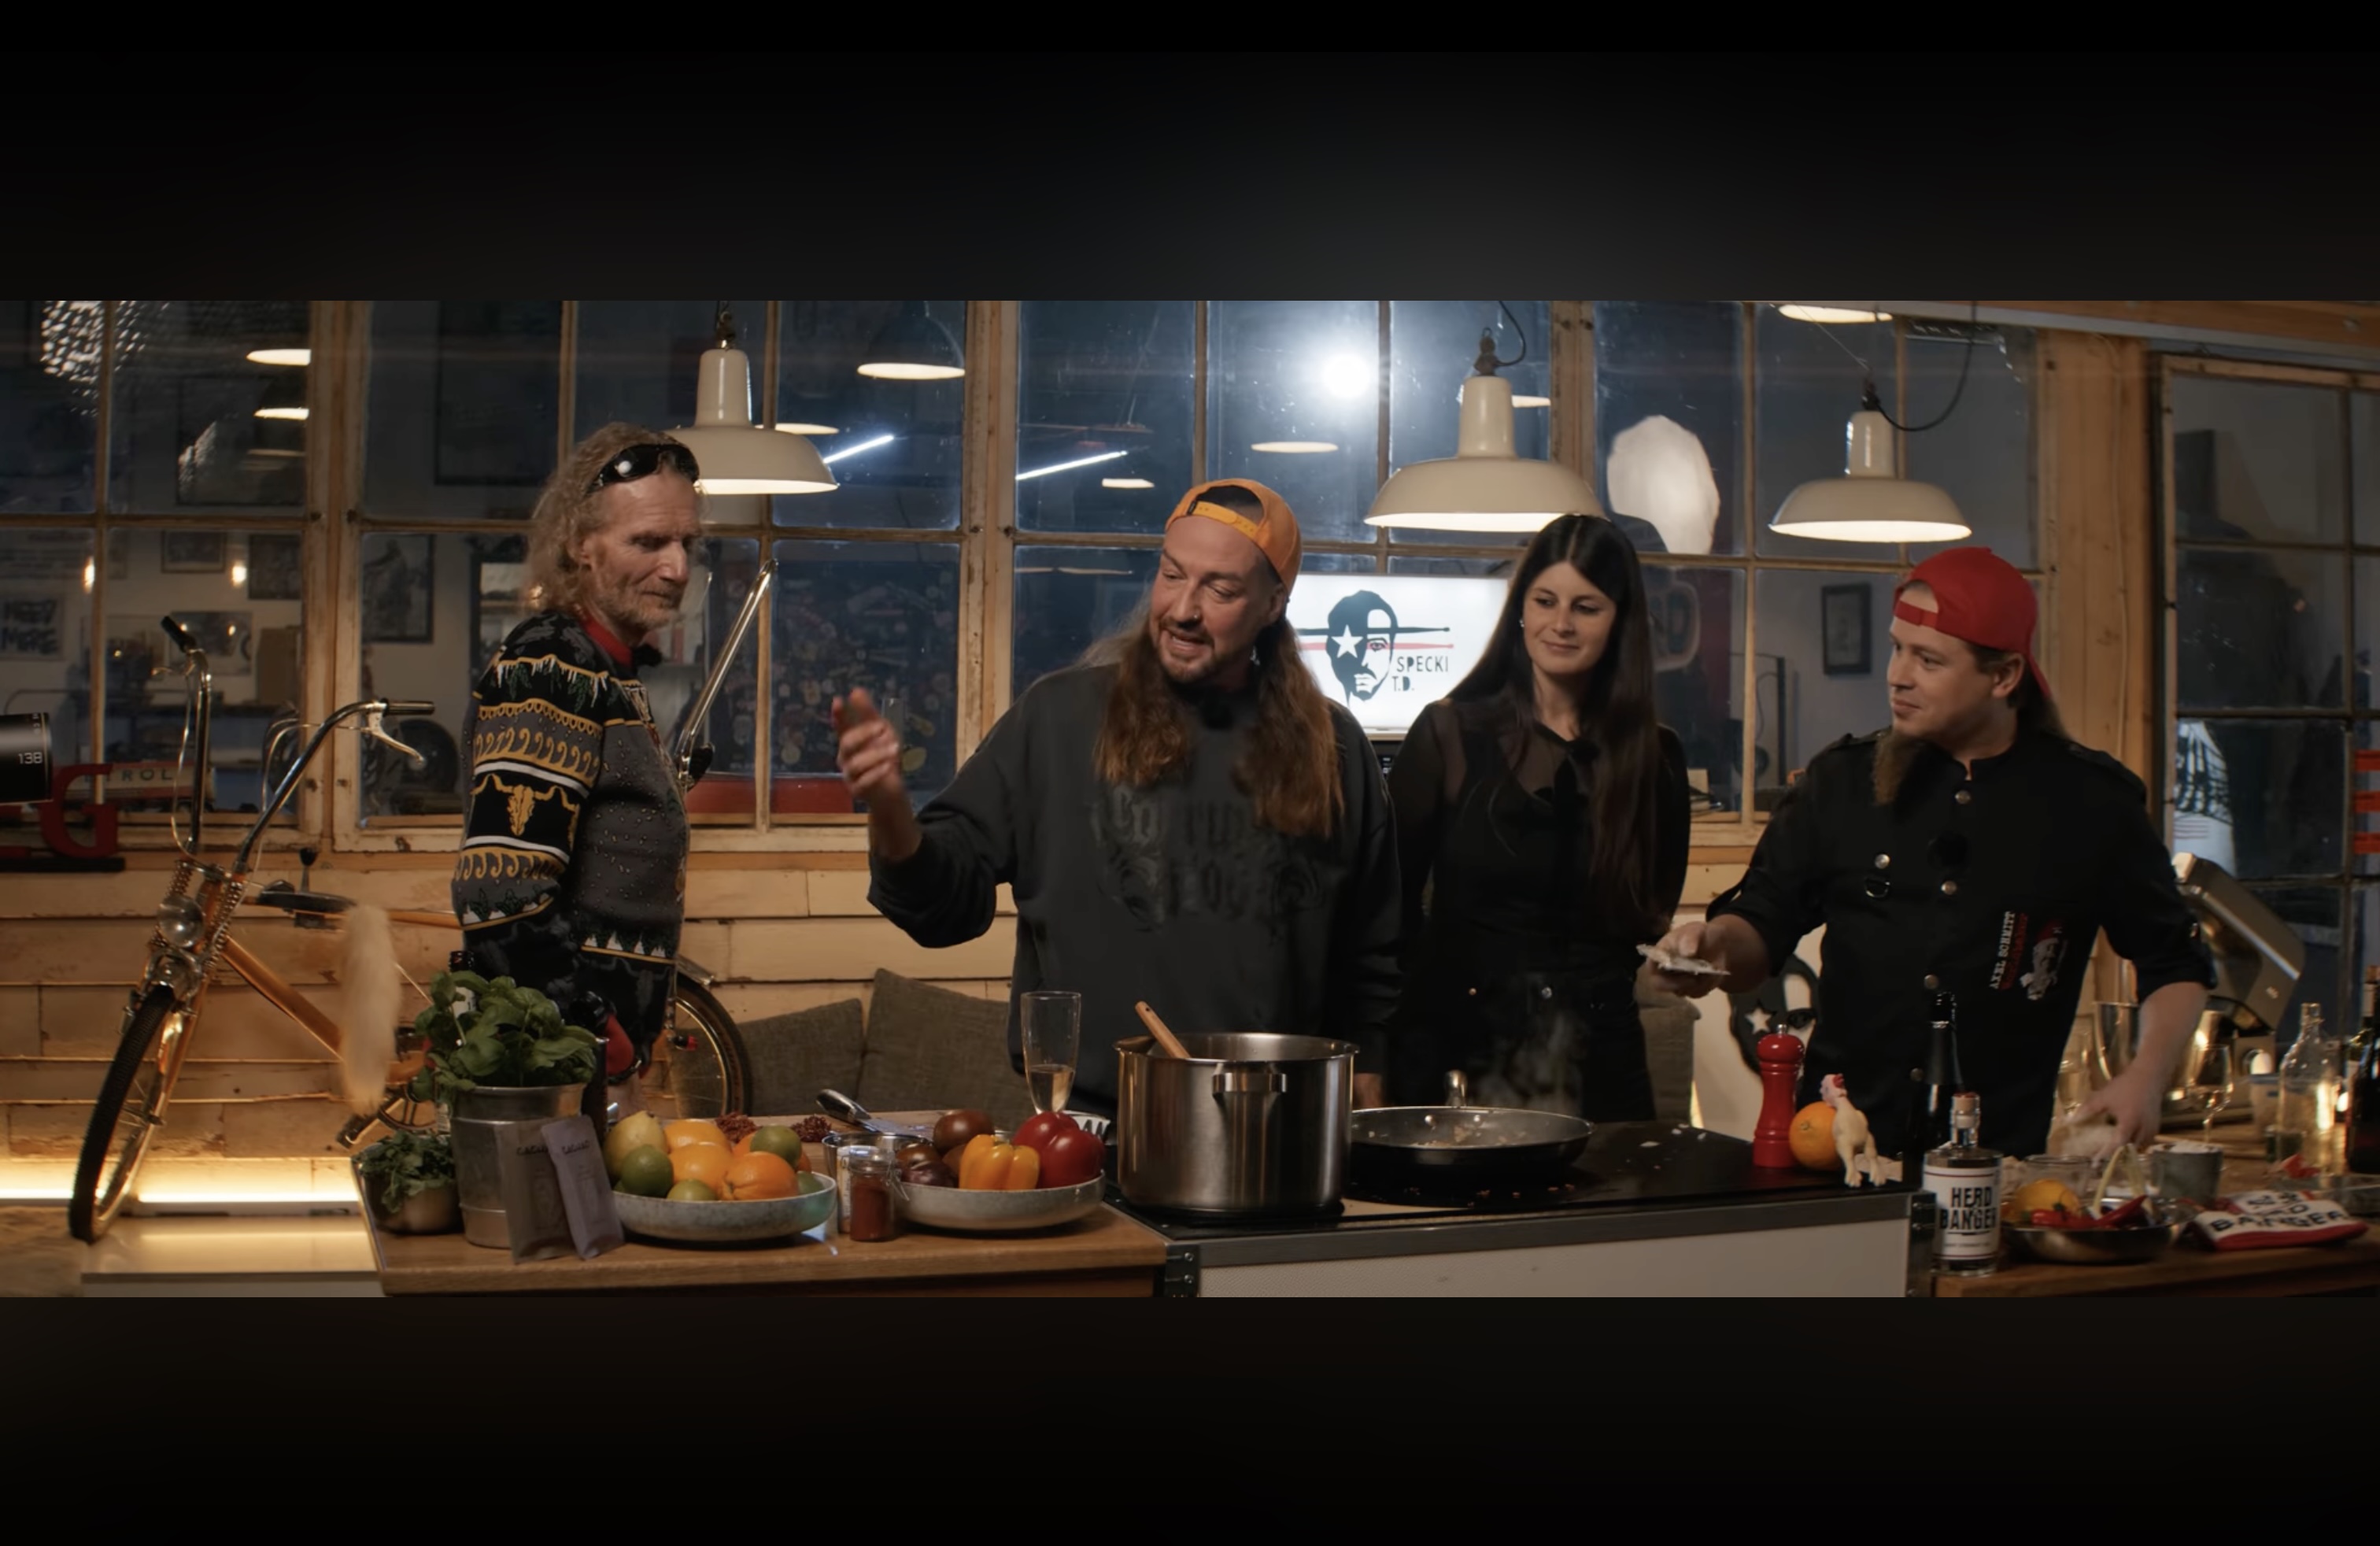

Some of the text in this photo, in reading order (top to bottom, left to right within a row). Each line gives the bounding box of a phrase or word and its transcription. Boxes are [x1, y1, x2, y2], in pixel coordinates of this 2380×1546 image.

[1396, 655, 1449, 673] SPECKI
[1391, 675, 1415, 692] T.D.
[18, 752, 43, 765] 138
[1989, 960, 2008, 990] AXEL
[1951, 1186, 1993, 1208] HERD
